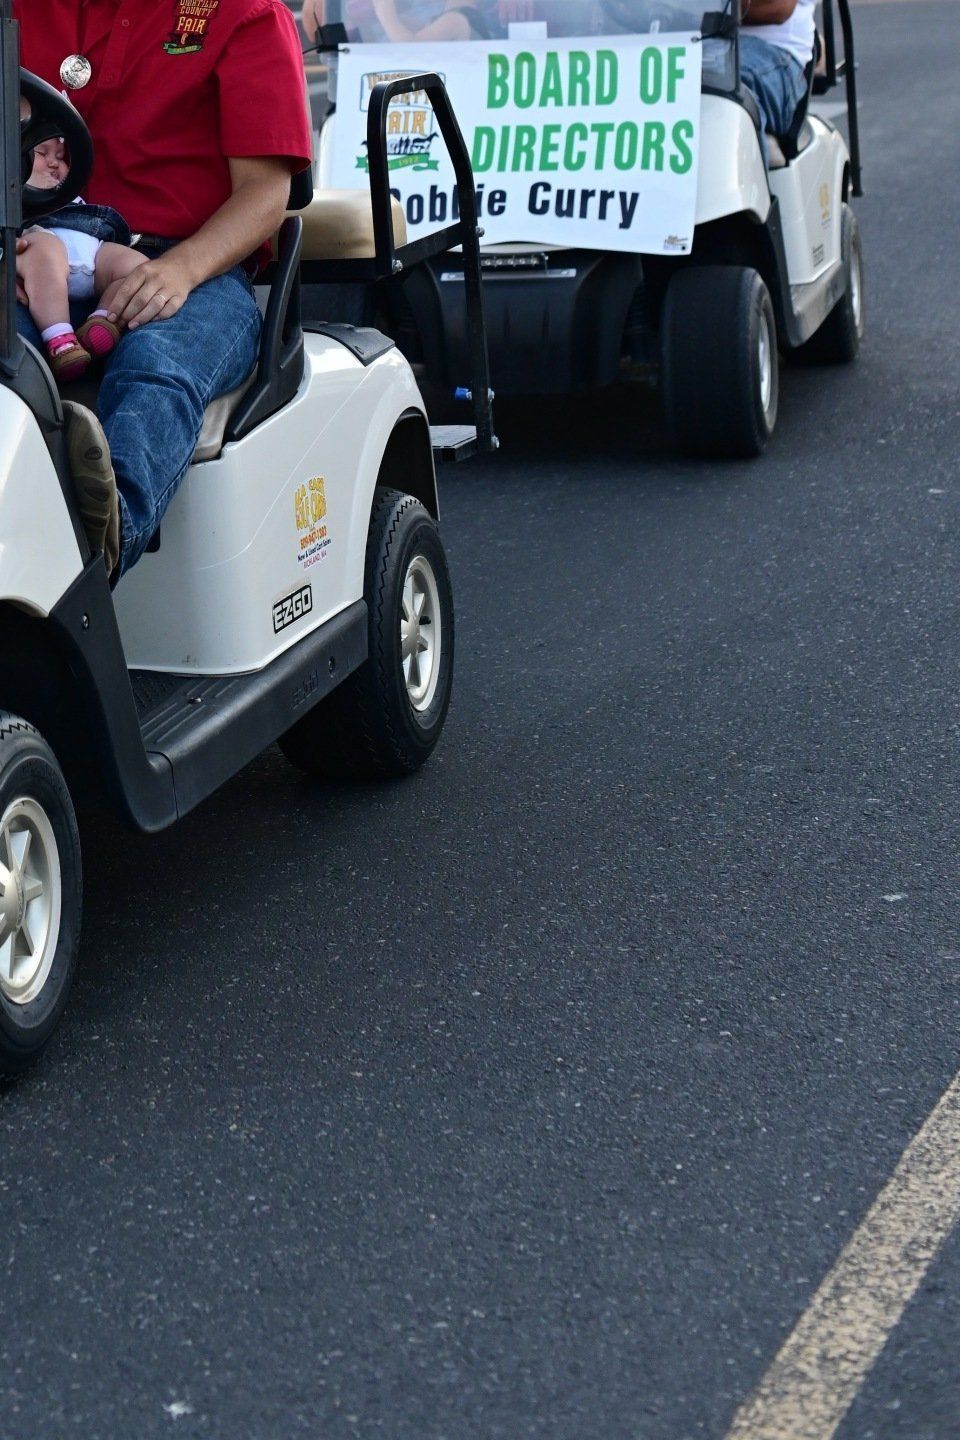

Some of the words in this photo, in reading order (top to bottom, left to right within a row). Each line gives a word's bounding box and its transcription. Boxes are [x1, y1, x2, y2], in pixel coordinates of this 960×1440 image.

[176, 16, 207, 34] FAIR
[179, 6, 213, 17] COUNTY
[486, 49, 619, 109] BOARD
[640, 46, 687, 105] OF
[388, 111, 427, 136] AIR
[471, 119, 694, 175] DIRECTORS
[390, 183, 507, 225] obie
[527, 181, 640, 229] Curry
